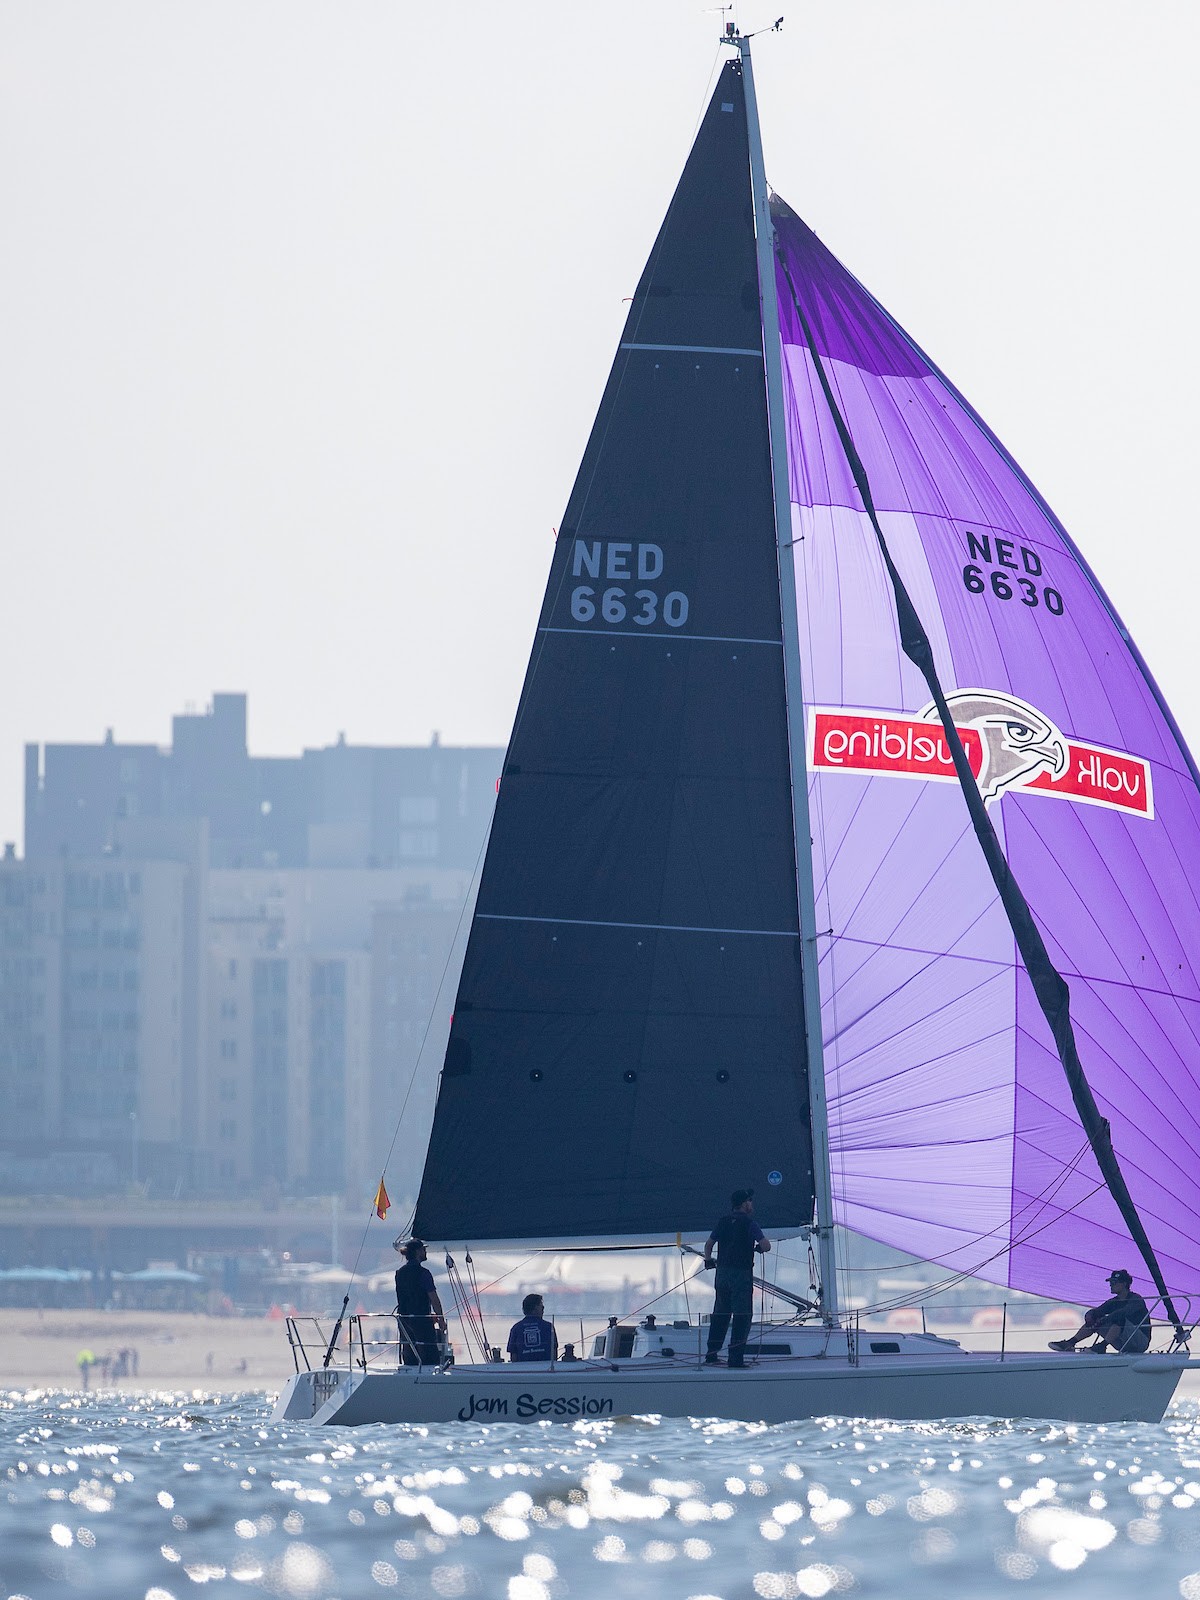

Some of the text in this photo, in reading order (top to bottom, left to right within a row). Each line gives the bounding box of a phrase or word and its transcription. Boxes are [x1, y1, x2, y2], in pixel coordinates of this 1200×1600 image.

[572, 539, 664, 580] NED
[965, 531, 1042, 577] NED
[570, 585, 689, 628] 6630
[963, 564, 1064, 616] 6630
[457, 1393, 613, 1421] Jam Session
